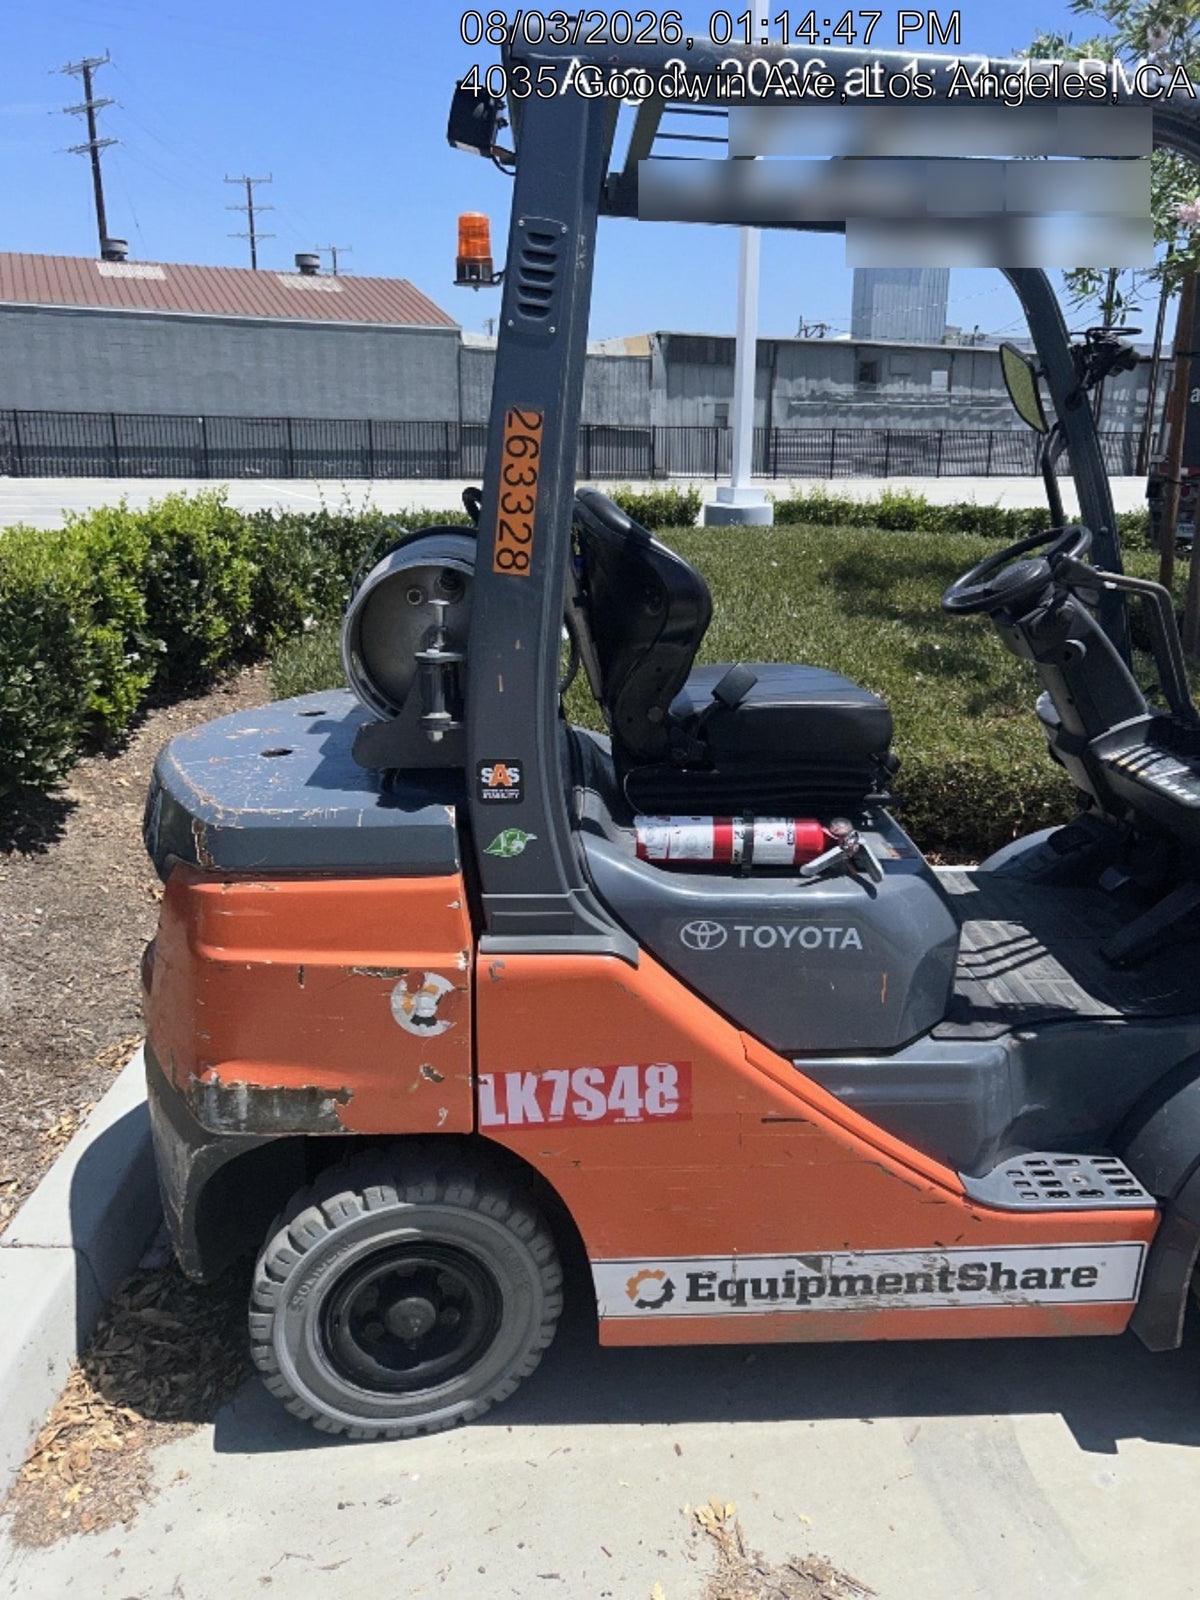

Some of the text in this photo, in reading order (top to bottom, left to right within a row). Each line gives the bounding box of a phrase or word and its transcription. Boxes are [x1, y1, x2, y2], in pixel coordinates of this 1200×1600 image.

[496, 406, 543, 570] 263328
[481, 764, 520, 786] SAS
[734, 926, 863, 950] TOYOTA
[479, 1063, 679, 1126] LK7S48
[686, 1262, 1098, 1307] EquipmentShare
